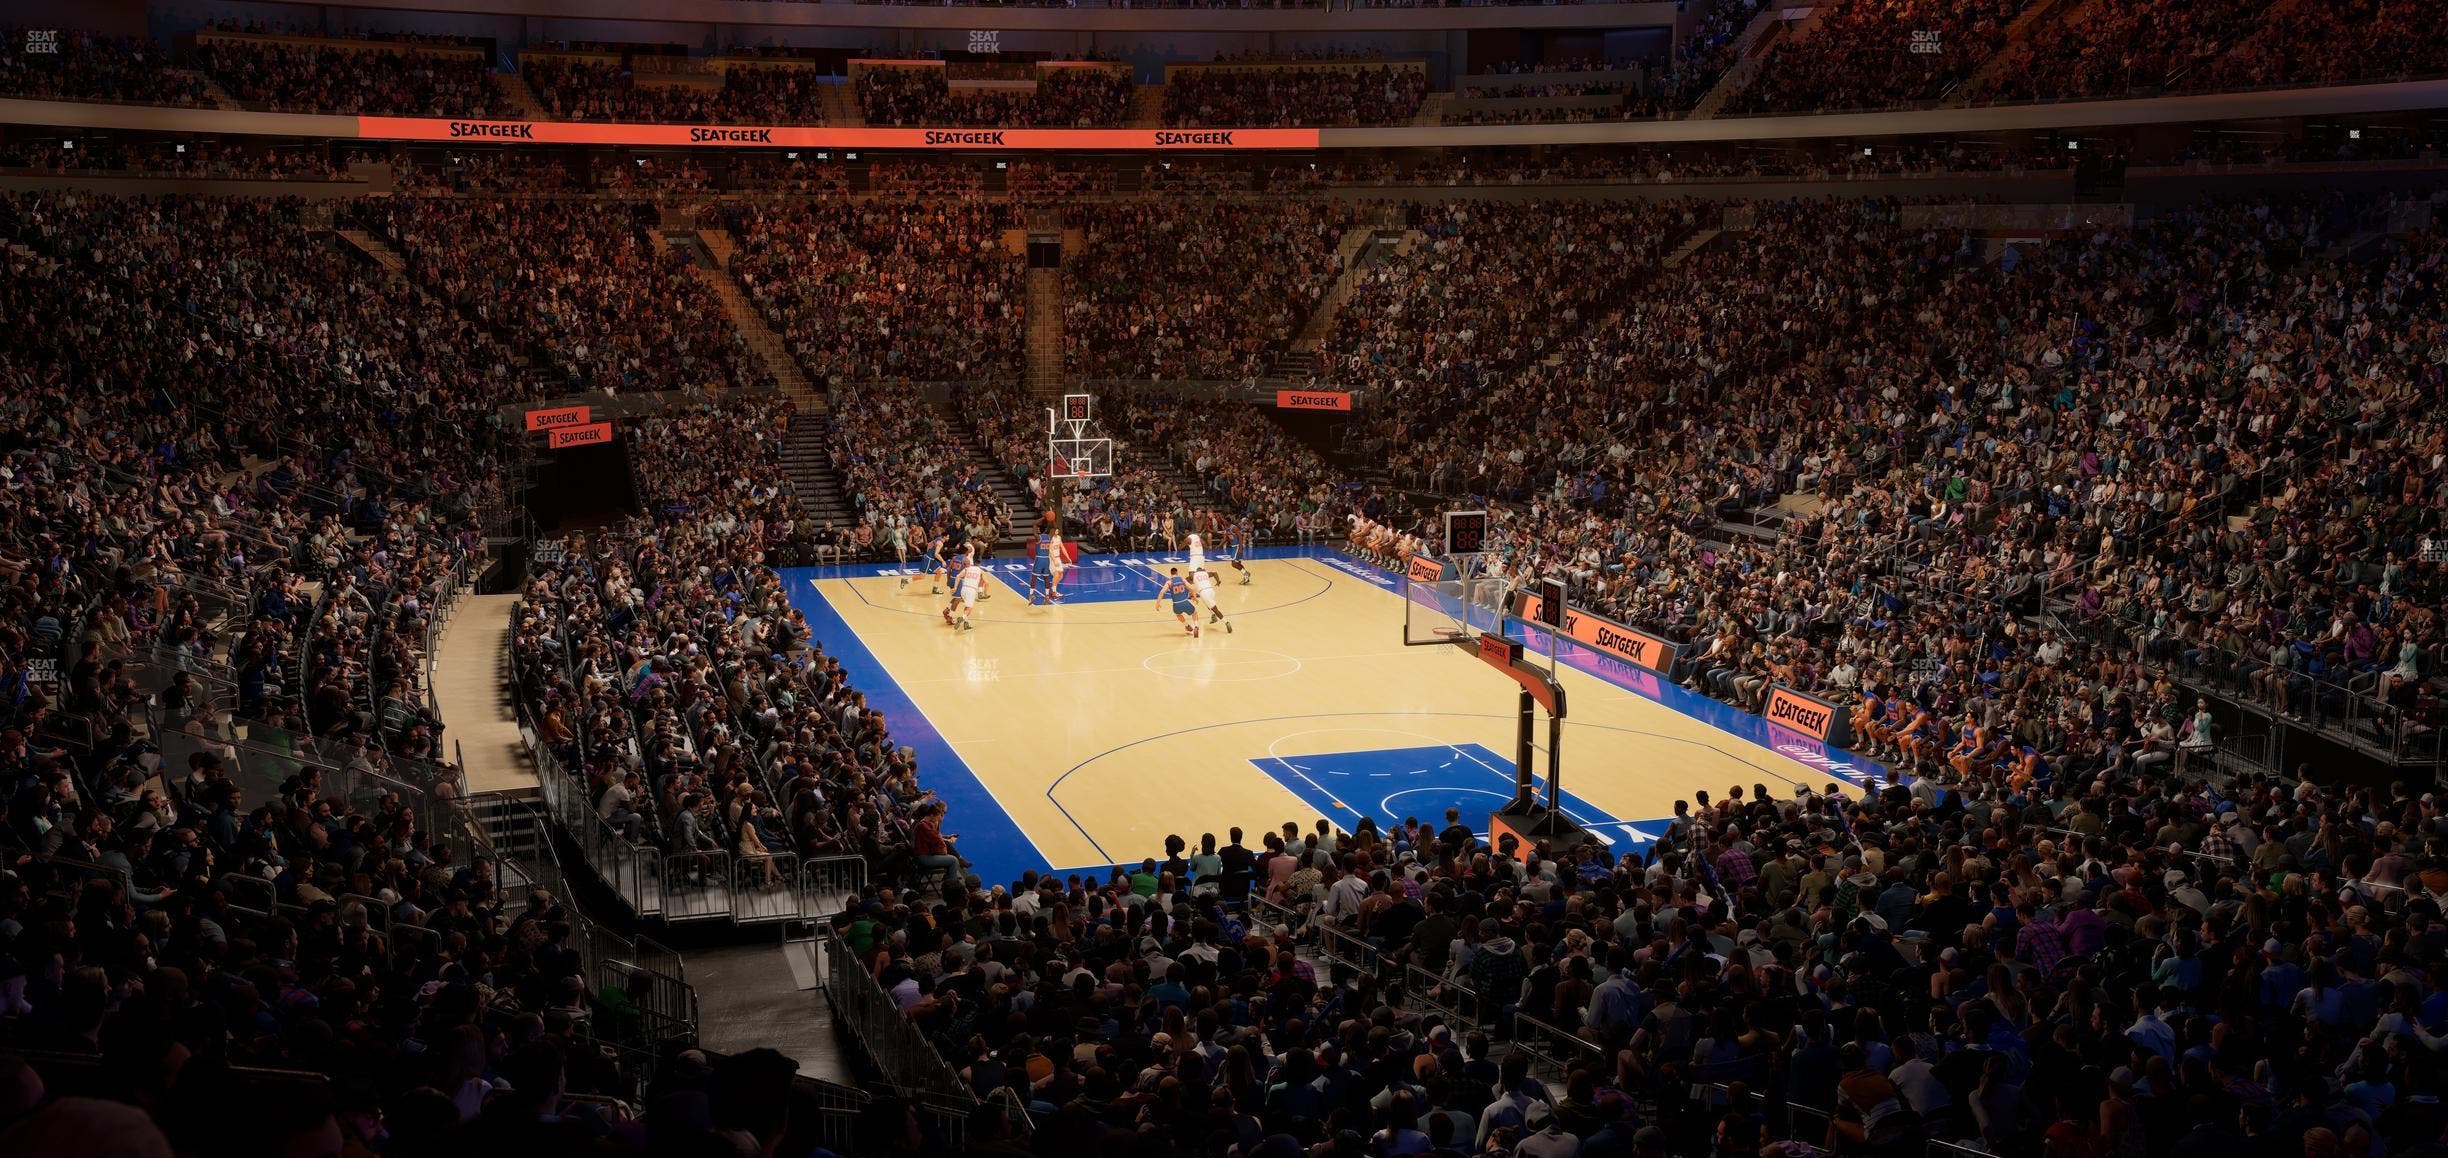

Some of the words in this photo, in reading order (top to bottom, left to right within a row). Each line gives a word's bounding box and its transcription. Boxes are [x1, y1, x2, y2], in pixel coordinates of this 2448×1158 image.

[449, 122, 533, 139] SEATGEEK
[690, 128, 771, 143] SEATGEEK
[925, 131, 1005, 145] SEATGEEK
[1155, 131, 1233, 145] SEATGEEK
[1290, 395, 1338, 407] SEATGEEK
[536, 411, 579, 427] SEATGEEK
[559, 428, 601, 445] SEATGEEK
[1410, 561, 1440, 582] SEATGEEK
[1483, 640, 1507, 659] SEATGEEK
[1595, 626, 1646, 662] SEATGEEK
[1771, 696, 1828, 735] SEATGEEK
